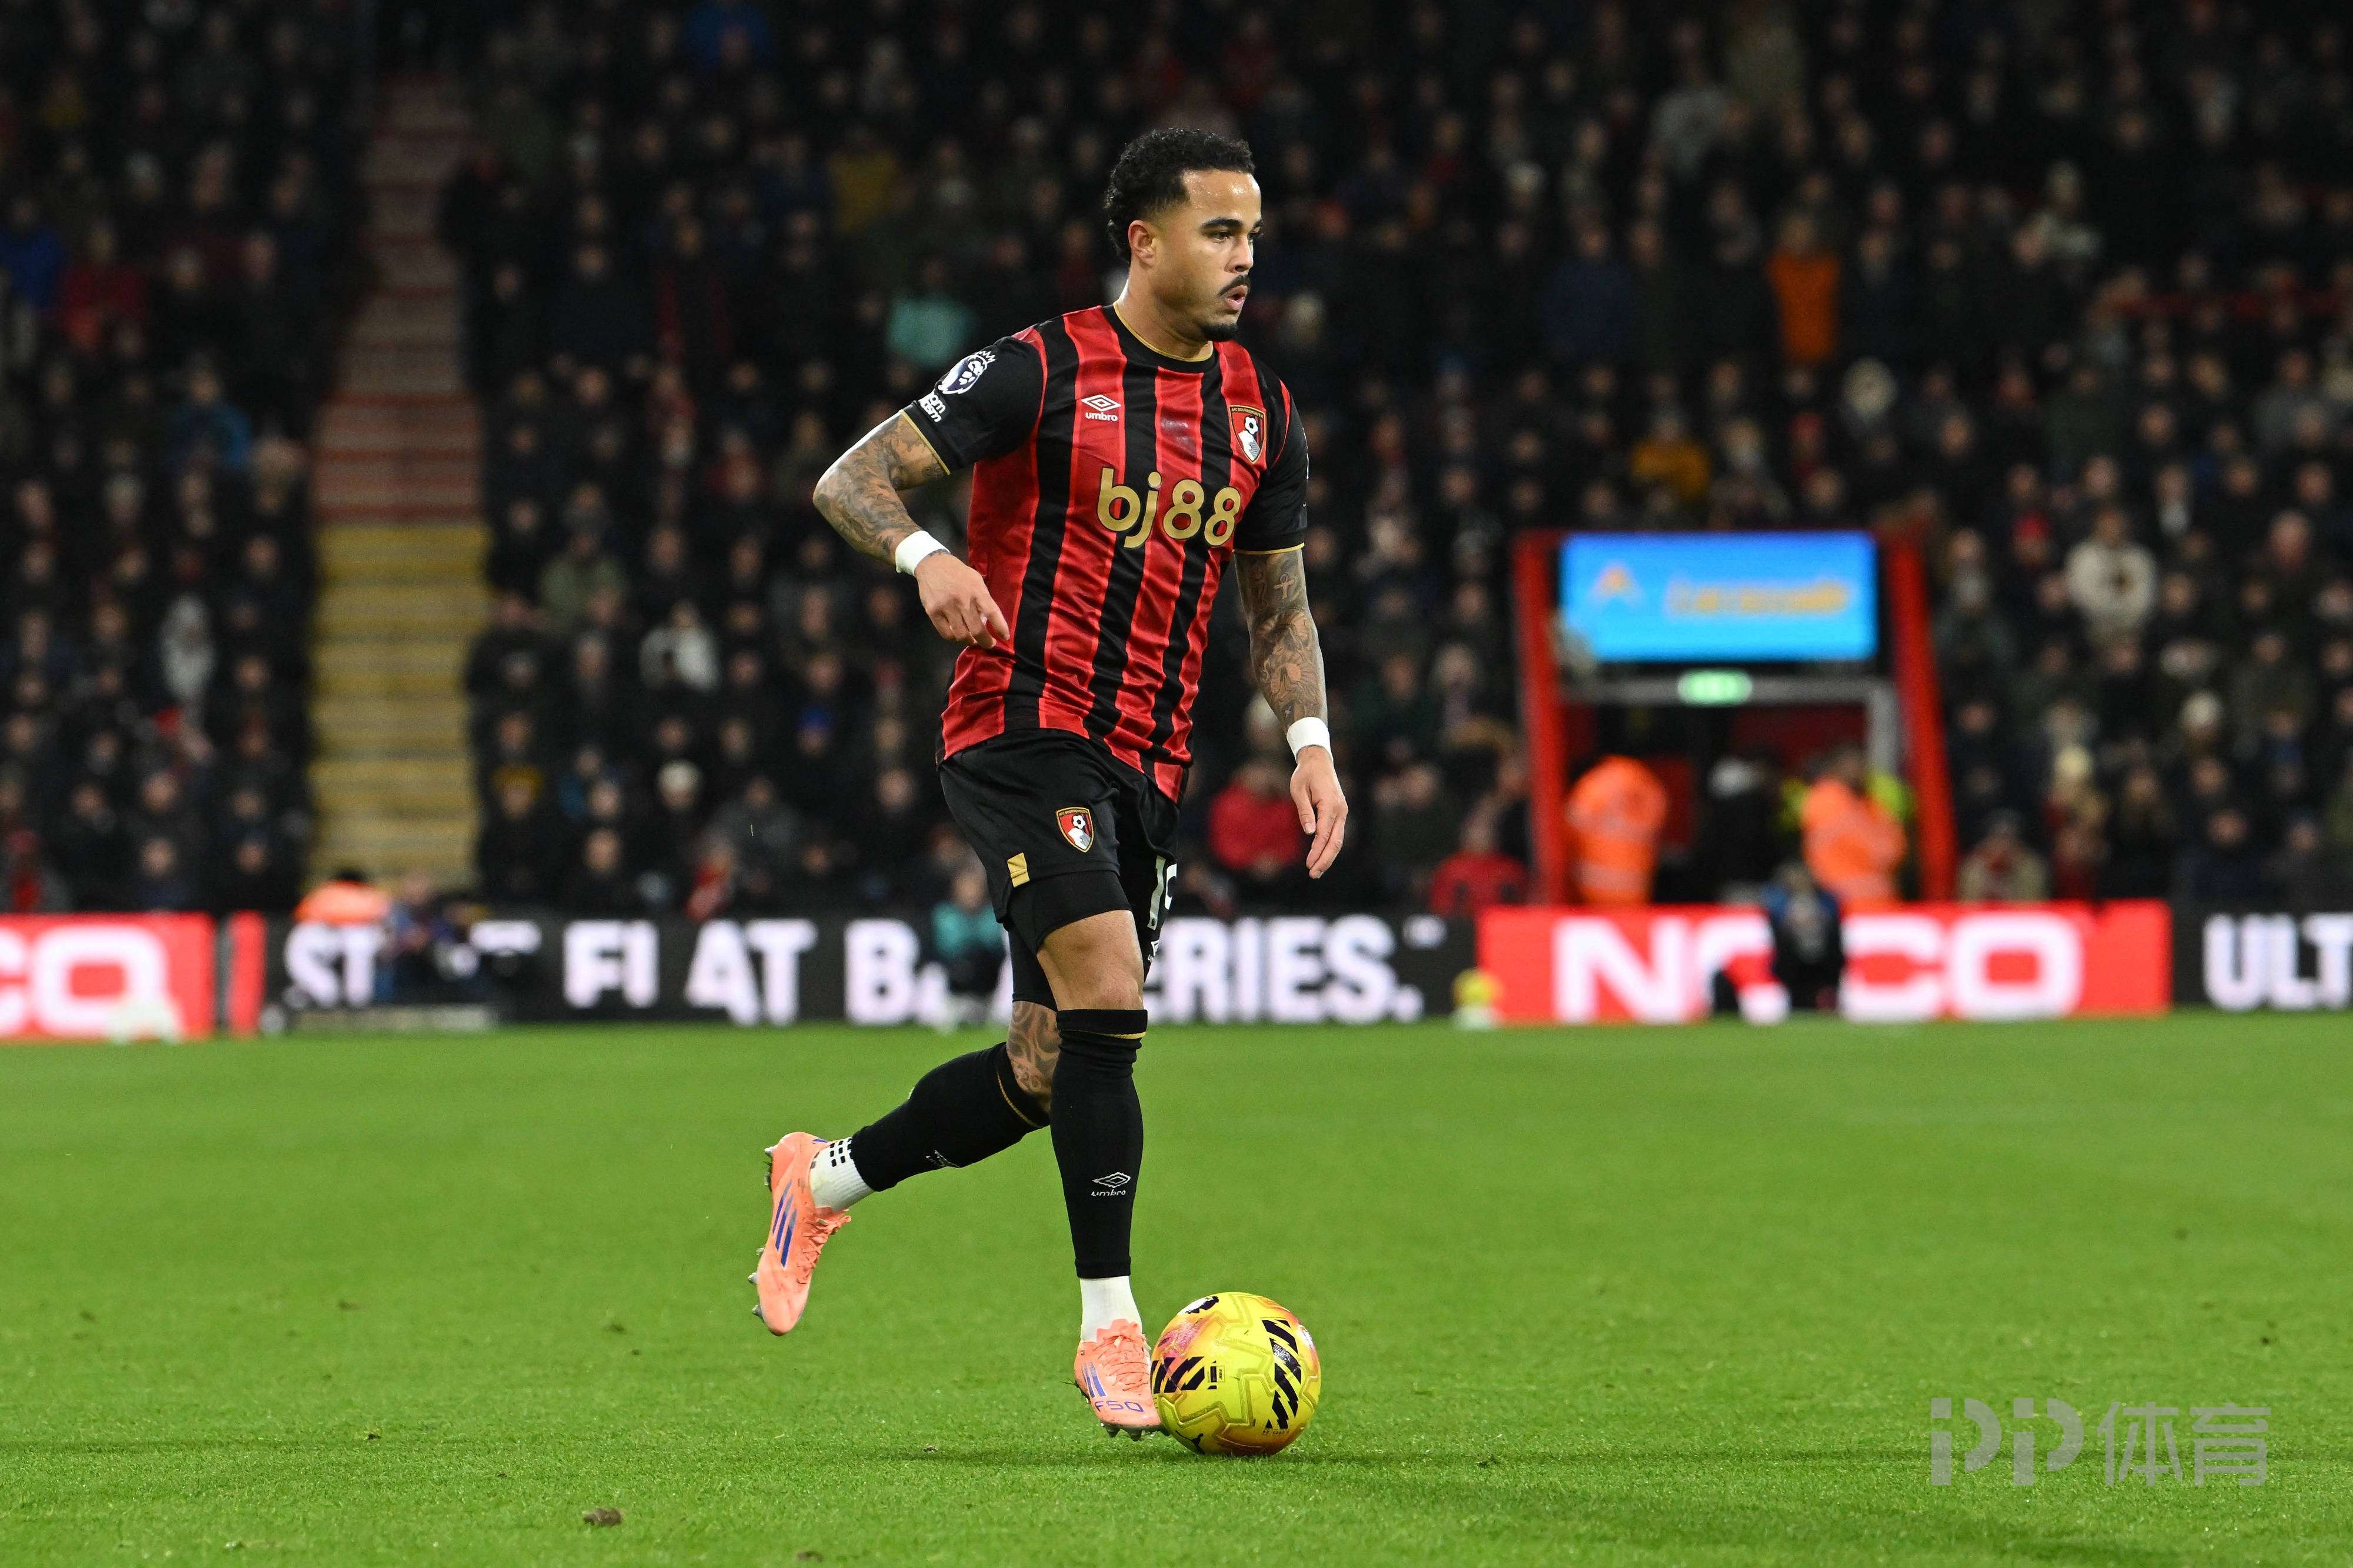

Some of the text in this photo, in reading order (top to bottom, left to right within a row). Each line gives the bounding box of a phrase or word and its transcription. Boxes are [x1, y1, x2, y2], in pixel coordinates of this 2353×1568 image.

[1085, 412, 1118, 422] umbro
[1097, 467, 1241, 548] bj88
[1095, 1400, 1144, 1412] F50
